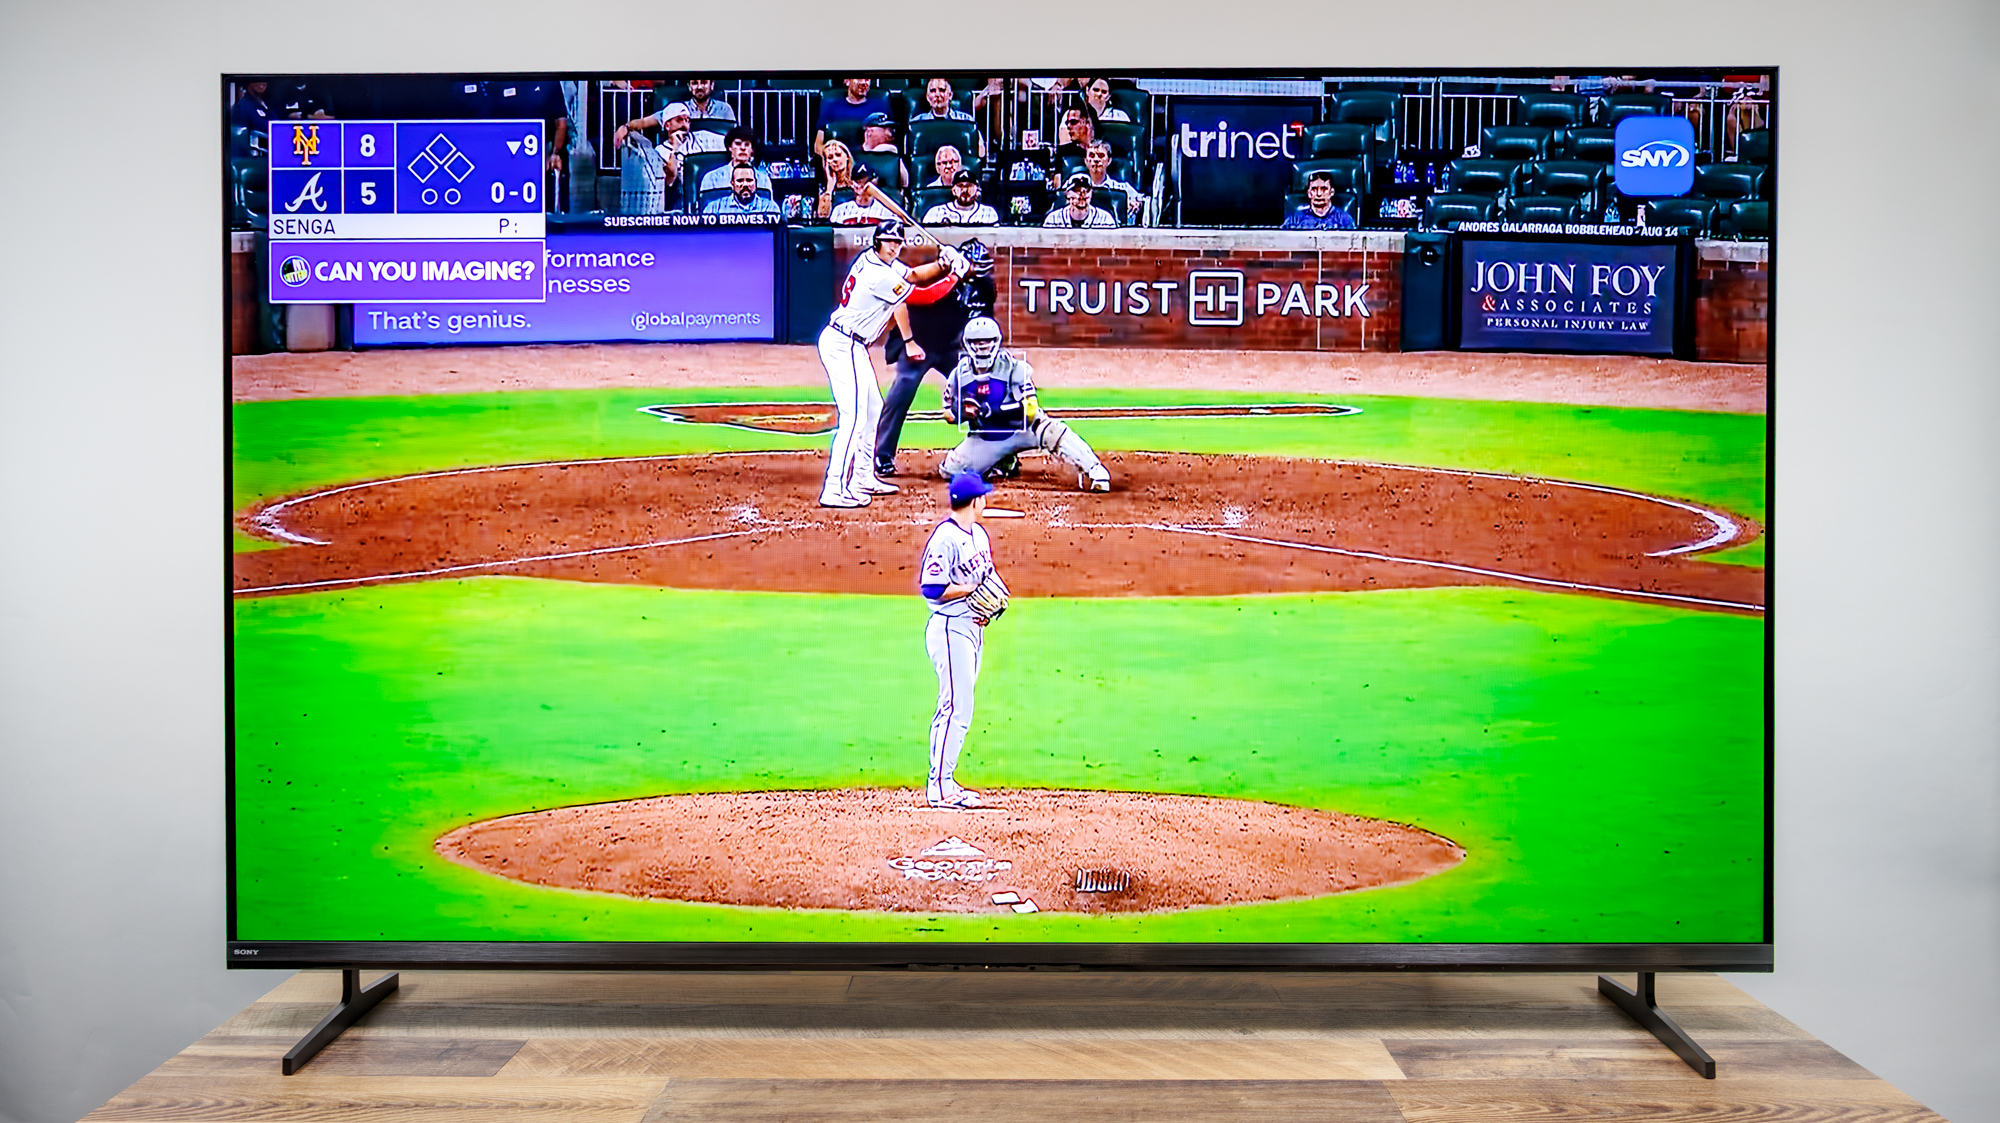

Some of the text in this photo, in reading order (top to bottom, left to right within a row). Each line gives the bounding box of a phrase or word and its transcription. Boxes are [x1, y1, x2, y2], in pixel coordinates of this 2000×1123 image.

[360, 133, 376, 157] 8
[523, 134, 538, 156] 9
[1181, 120, 1297, 159] trinet
[1621, 140, 1690, 167] SNY
[360, 181, 377, 205] 5
[273, 219, 336, 235] SENGA
[604, 214, 781, 227] SUBSCRIBE NOW TO BRAVES.TV
[1458, 221, 1499, 232] ANDRES
[1565, 224, 1633, 235] BOBBLEHEAD
[1640, 225, 1663, 236] AUG
[1664, 226, 1679, 237] 14
[314, 261, 363, 282] CAN
[367, 261, 417, 281] YOU
[422, 260, 536, 281] IMAGINE?
[1470, 261, 1665, 297] JOHN FOY
[1019, 280, 1370, 318] TRUIST PARK
[447, 309, 532, 334] genius.
[1486, 317, 1650, 331] PERSONAL INJURY LAW
